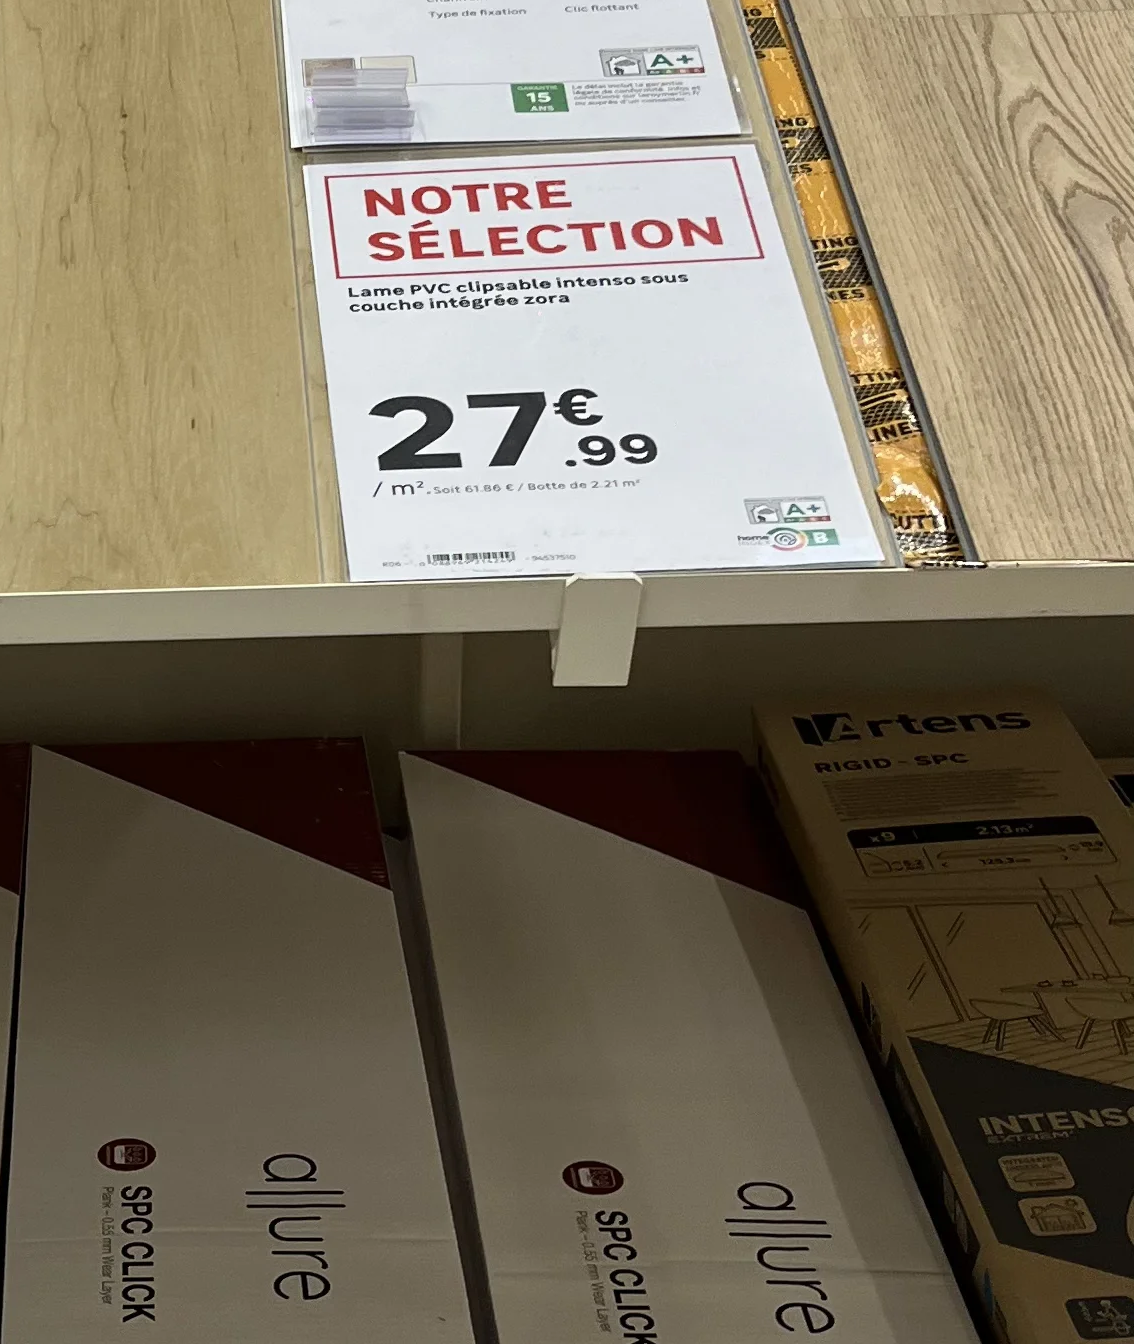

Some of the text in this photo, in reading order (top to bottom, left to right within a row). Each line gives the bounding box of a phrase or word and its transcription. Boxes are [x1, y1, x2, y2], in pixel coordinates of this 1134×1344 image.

[428, 7, 527, 19] Type de fixation
[564, 2, 640, 14] Clic flottant
[650, 53, 694, 68] A+
[526, 91, 552, 104] 15
[529, 104, 555, 112] ANS
[363, 180, 572, 217] NOTRE
[369, 215, 723, 262] SÉLECTION
[811, 236, 858, 249] TING
[348, 271, 689, 299] Lame PVC clipsable intenso sous
[827, 288, 865, 301] NES
[349, 293, 570, 313] couche intégrée zora
[850, 371, 902, 385] TTIN
[368, 391, 548, 472] 27
[433, 484, 461, 494] Soit
[528, 481, 566, 491] Botte
[570, 480, 587, 489] de
[591, 479, 619, 489] 2.21
[786, 503, 821, 516] A+
[812, 531, 829, 544] B
[814, 753, 970, 773] RIGID SPC
[867, 831, 897, 845] x9
[977, 1106, 1134, 1136] INTENS
[246, 1154, 346, 1300] allure
[595, 1210, 637, 1261] SPC
[120, 1185, 156, 1323] SPC CLICK
[725, 1182, 835, 1333] allure
